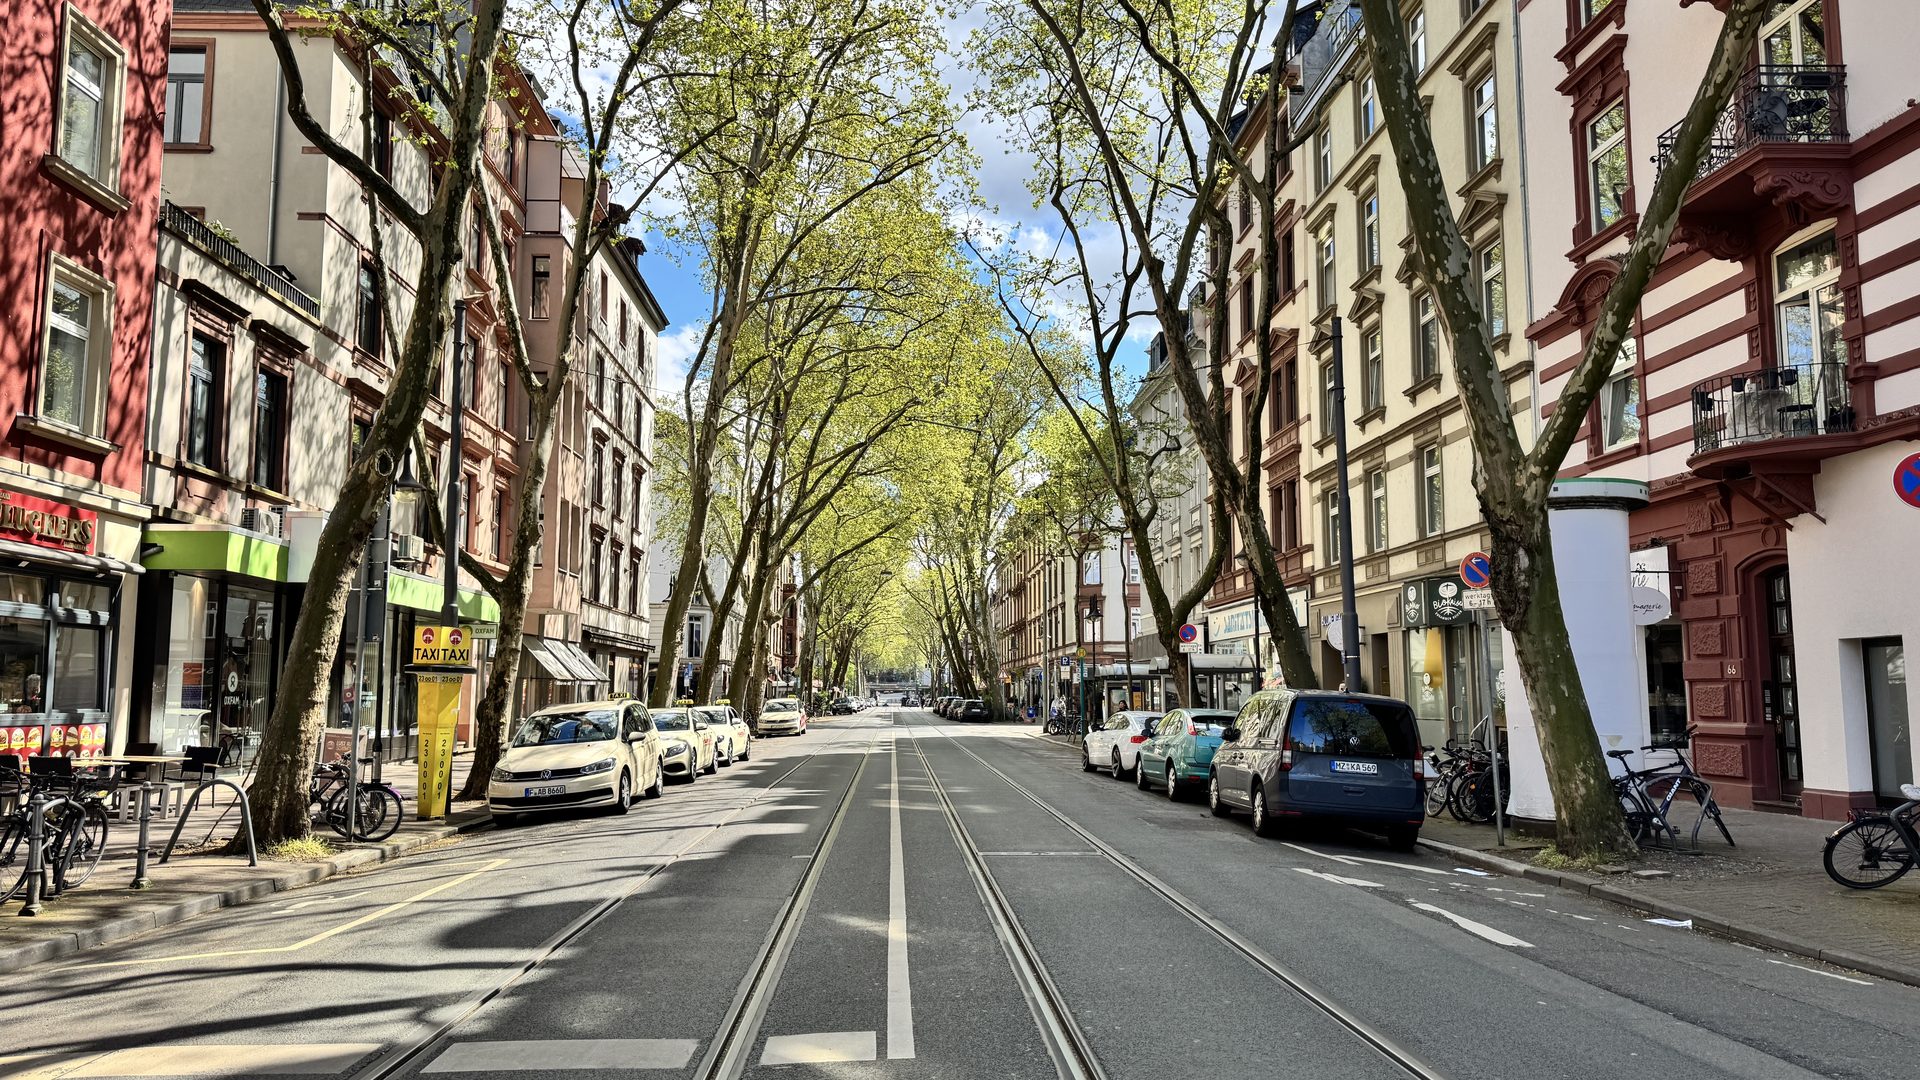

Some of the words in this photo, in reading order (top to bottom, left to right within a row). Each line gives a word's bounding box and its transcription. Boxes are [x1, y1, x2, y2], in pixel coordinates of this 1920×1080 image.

[0, 503, 93, 545] LUCKERS
[1633, 603, 1662, 614] magerie
[414, 648, 440, 660] TAXI
[441, 648, 470, 661] TAXI
[1727, 664, 1737, 674] 66
[224, 696, 240, 705] OXFAM
[1350, 763, 1361, 771] KA
[1362, 764, 1377, 772] 569
[547, 786, 564, 794] 8660
[1666, 777, 1681, 801] GIANT
